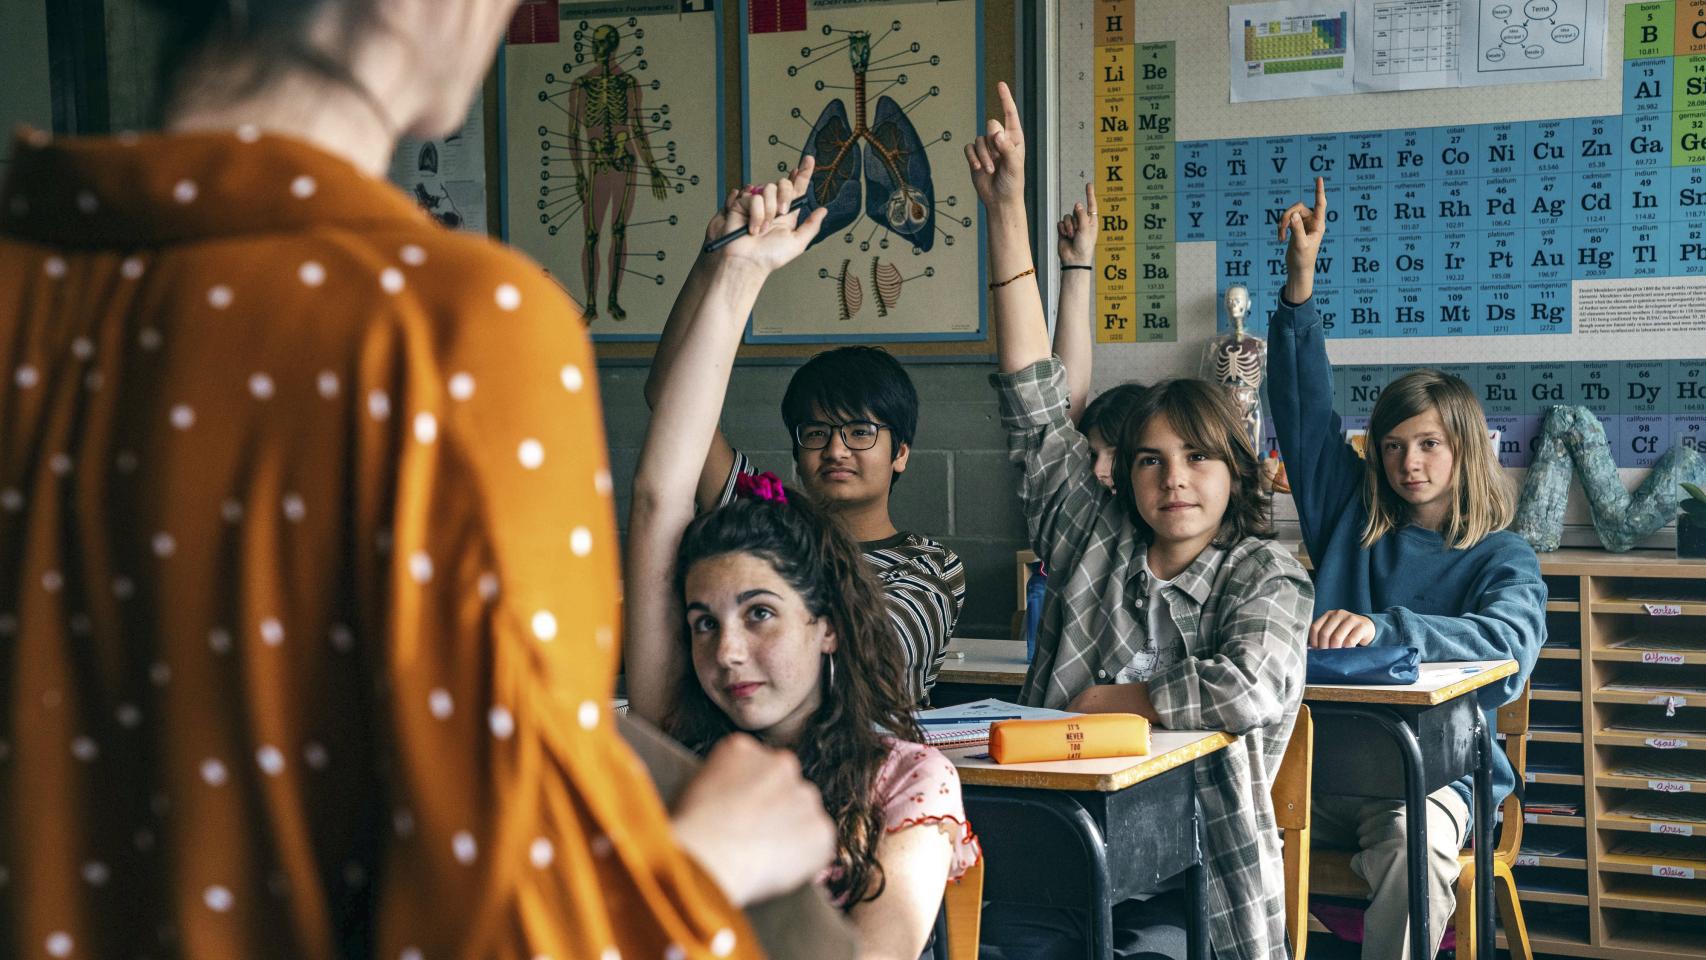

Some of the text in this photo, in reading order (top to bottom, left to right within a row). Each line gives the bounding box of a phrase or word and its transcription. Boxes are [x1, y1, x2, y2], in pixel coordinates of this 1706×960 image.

[1106, 16, 1122, 32] H
[1641, 26, 1657, 43] B
[1104, 66, 1124, 82] Li
[1142, 64, 1167, 80] Be
[1634, 81, 1661, 99] Al
[1101, 116, 1128, 132] Na
[1139, 114, 1171, 133] Mg
[1534, 142, 1564, 159] Cu
[1582, 140, 1612, 157] Zn
[1630, 136, 1663, 154] Ga
[1348, 153, 1383, 169] Mn
[1397, 150, 1423, 167] Fe
[1442, 148, 1469, 164] Co
[1488, 145, 1515, 162] Ni
[1184, 162, 1206, 178] Sc
[1227, 160, 1246, 176] Ti
[1271, 158, 1287, 173] V
[1310, 155, 1334, 172] Cr
[1106, 166, 1123, 181] K
[1143, 164, 1168, 180] Ca
[1487, 198, 1516, 215] Pd
[1532, 197, 1565, 217] Ag
[1581, 193, 1611, 211] Cd
[1633, 192, 1658, 208] In
[1354, 205, 1377, 221] Tc
[1394, 203, 1426, 219] Ru
[1439, 200, 1471, 217] Rh
[1102, 216, 1128, 231] Rb
[1144, 214, 1166, 230] Sr
[1188, 212, 1203, 228] Y
[1226, 211, 1248, 226] Zr
[1445, 254, 1465, 269] Ir
[1489, 252, 1513, 268] Pt
[1531, 250, 1564, 266] Au
[1578, 248, 1614, 269] Hg
[1633, 246, 1656, 262] Tl
[1225, 260, 1251, 276] Hf
[1315, 258, 1332, 274] W
[1352, 257, 1379, 272] Re
[1396, 255, 1424, 271] Os
[1104, 265, 1127, 280] Cs
[1143, 264, 1169, 279] Ba
[1143, 313, 1170, 328] Ra
[1351, 308, 1381, 324] Bh
[1396, 307, 1424, 323] Hs
[1440, 306, 1470, 322] Mt
[1486, 305, 1515, 320] Ds
[1531, 303, 1564, 324] Rg
[1104, 314, 1128, 329] Fr
[1351, 386, 1382, 403] Nd
[1486, 384, 1517, 400] Eu
[1532, 384, 1564, 400] Gd
[1581, 383, 1610, 400] Tb
[1628, 383, 1661, 404] Dy
[1632, 436, 1658, 453] Cf
